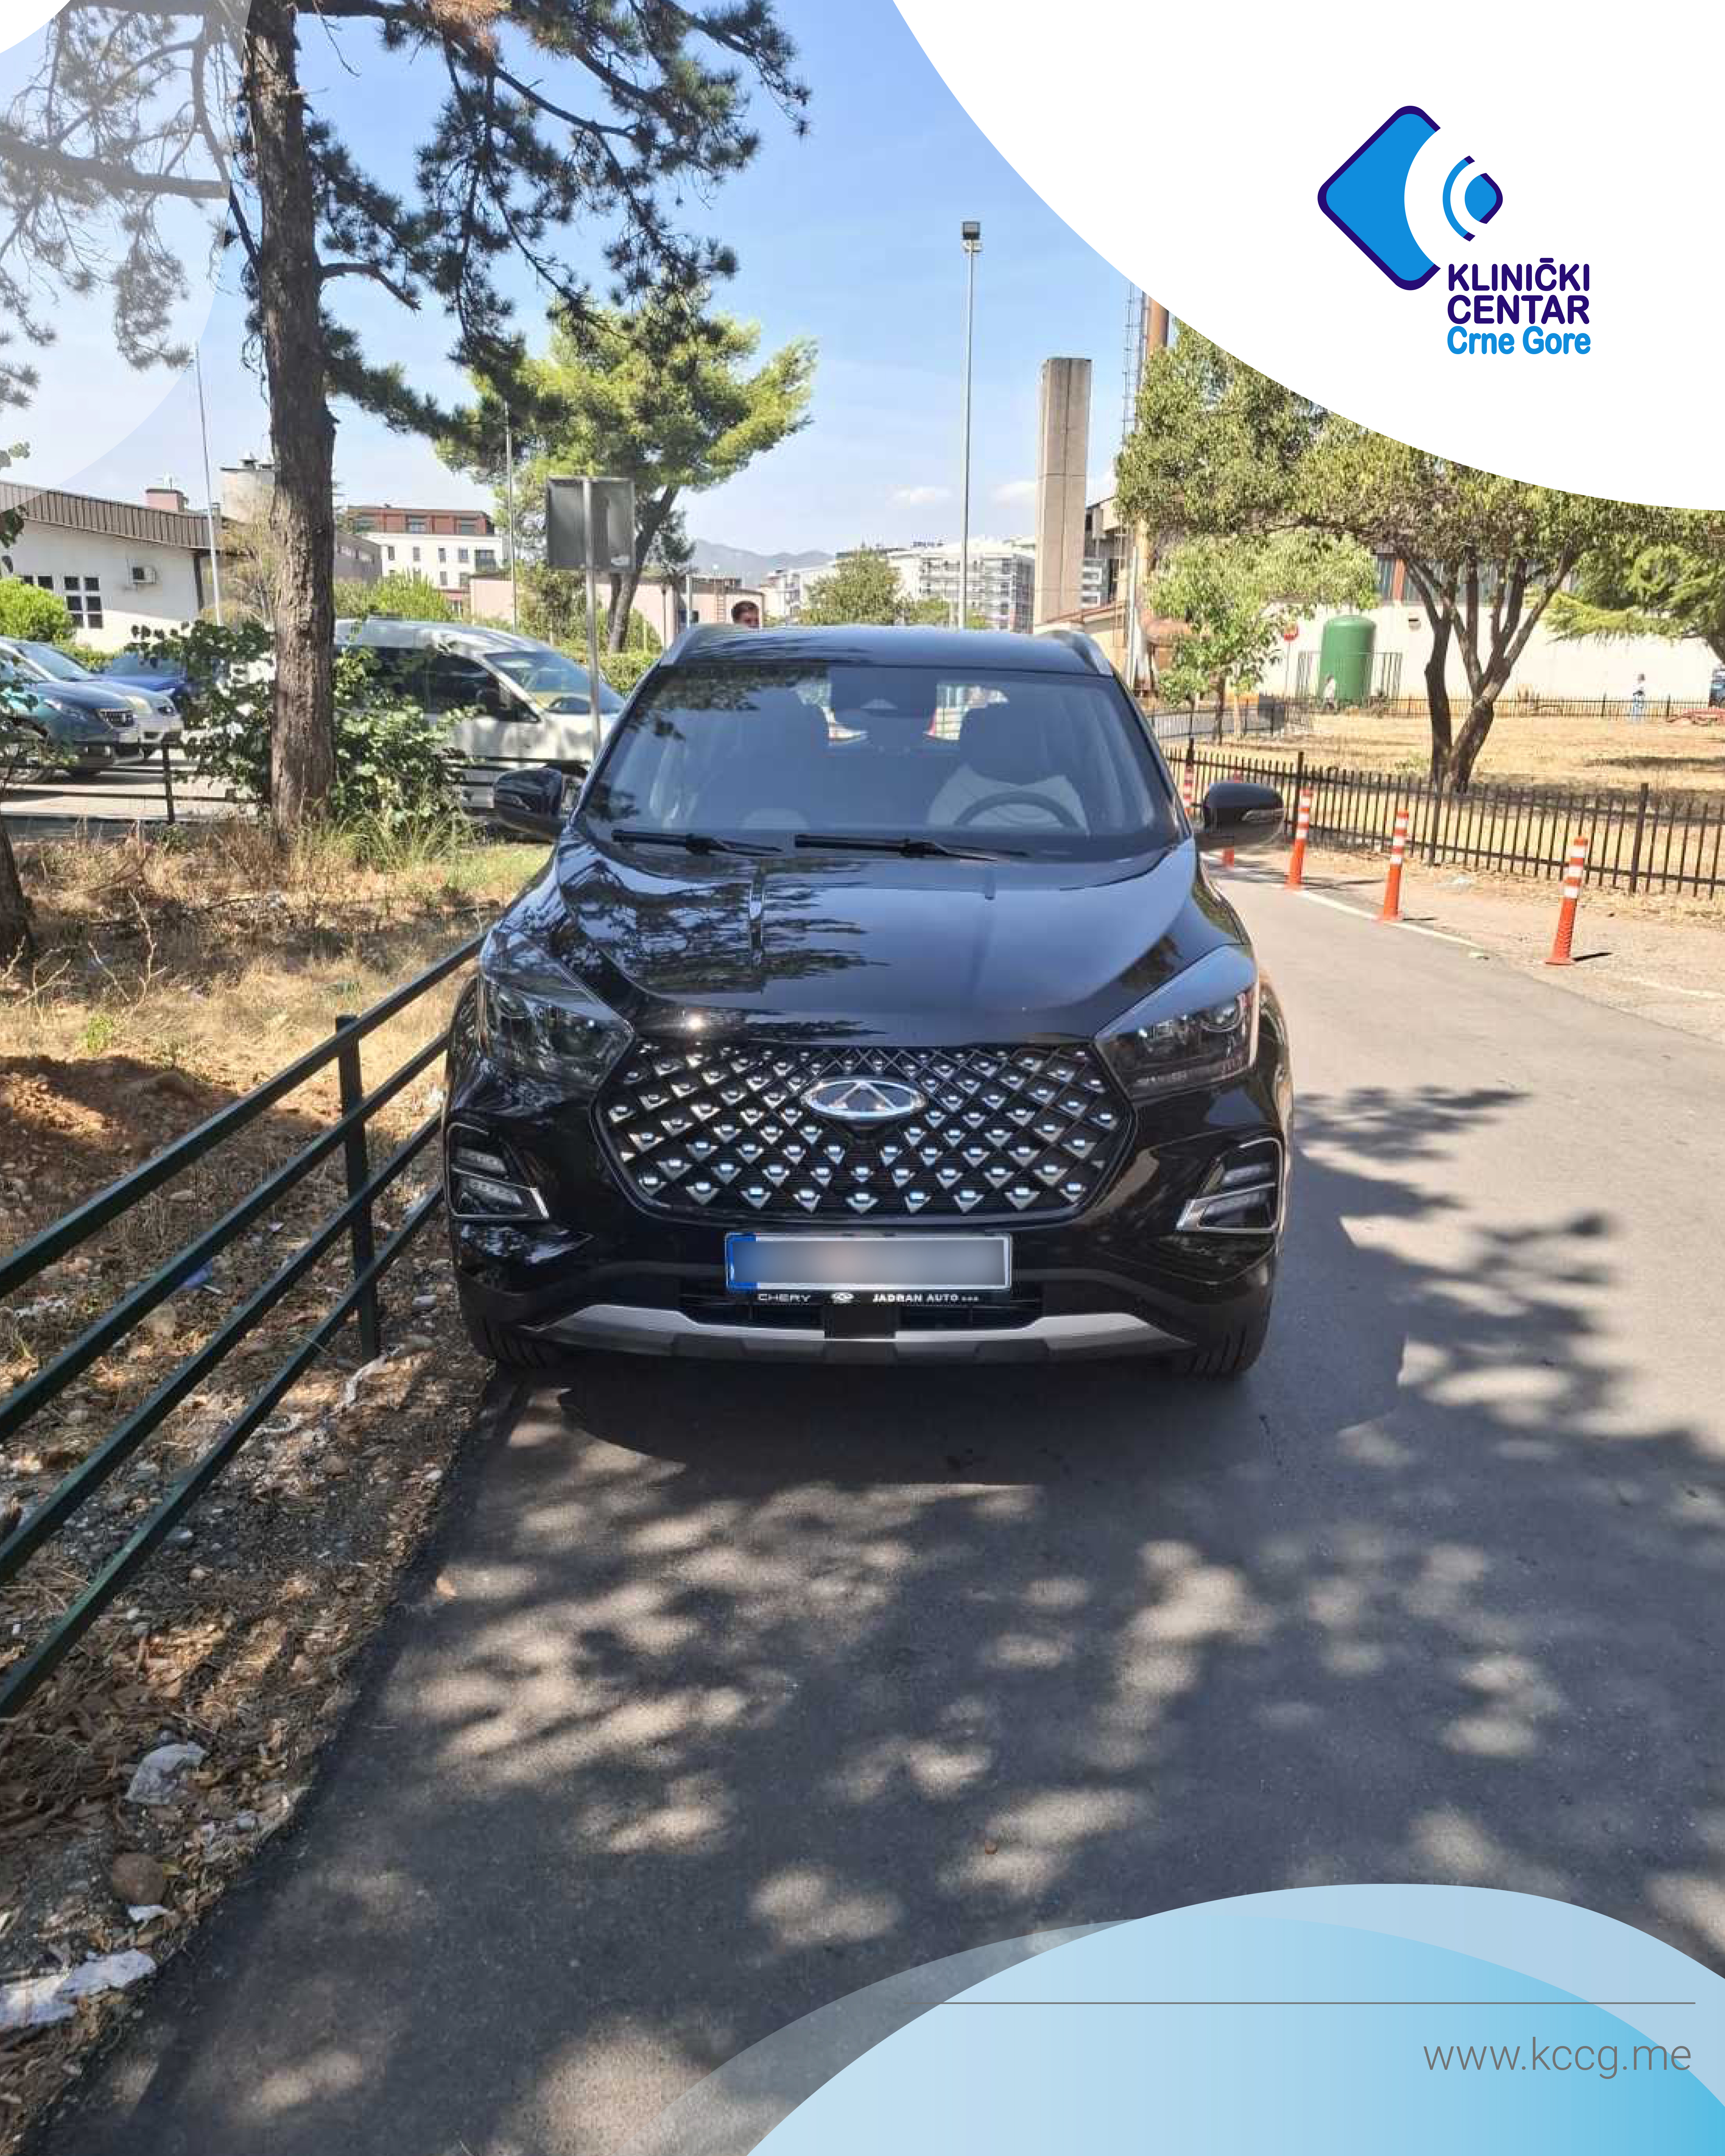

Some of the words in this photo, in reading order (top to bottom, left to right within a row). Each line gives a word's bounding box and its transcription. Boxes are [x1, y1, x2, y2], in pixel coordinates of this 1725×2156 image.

[758, 1293, 811, 1302] CHERY
[872, 1293, 923, 1302] JADRAN
[926, 1293, 959, 1302] AUTO
